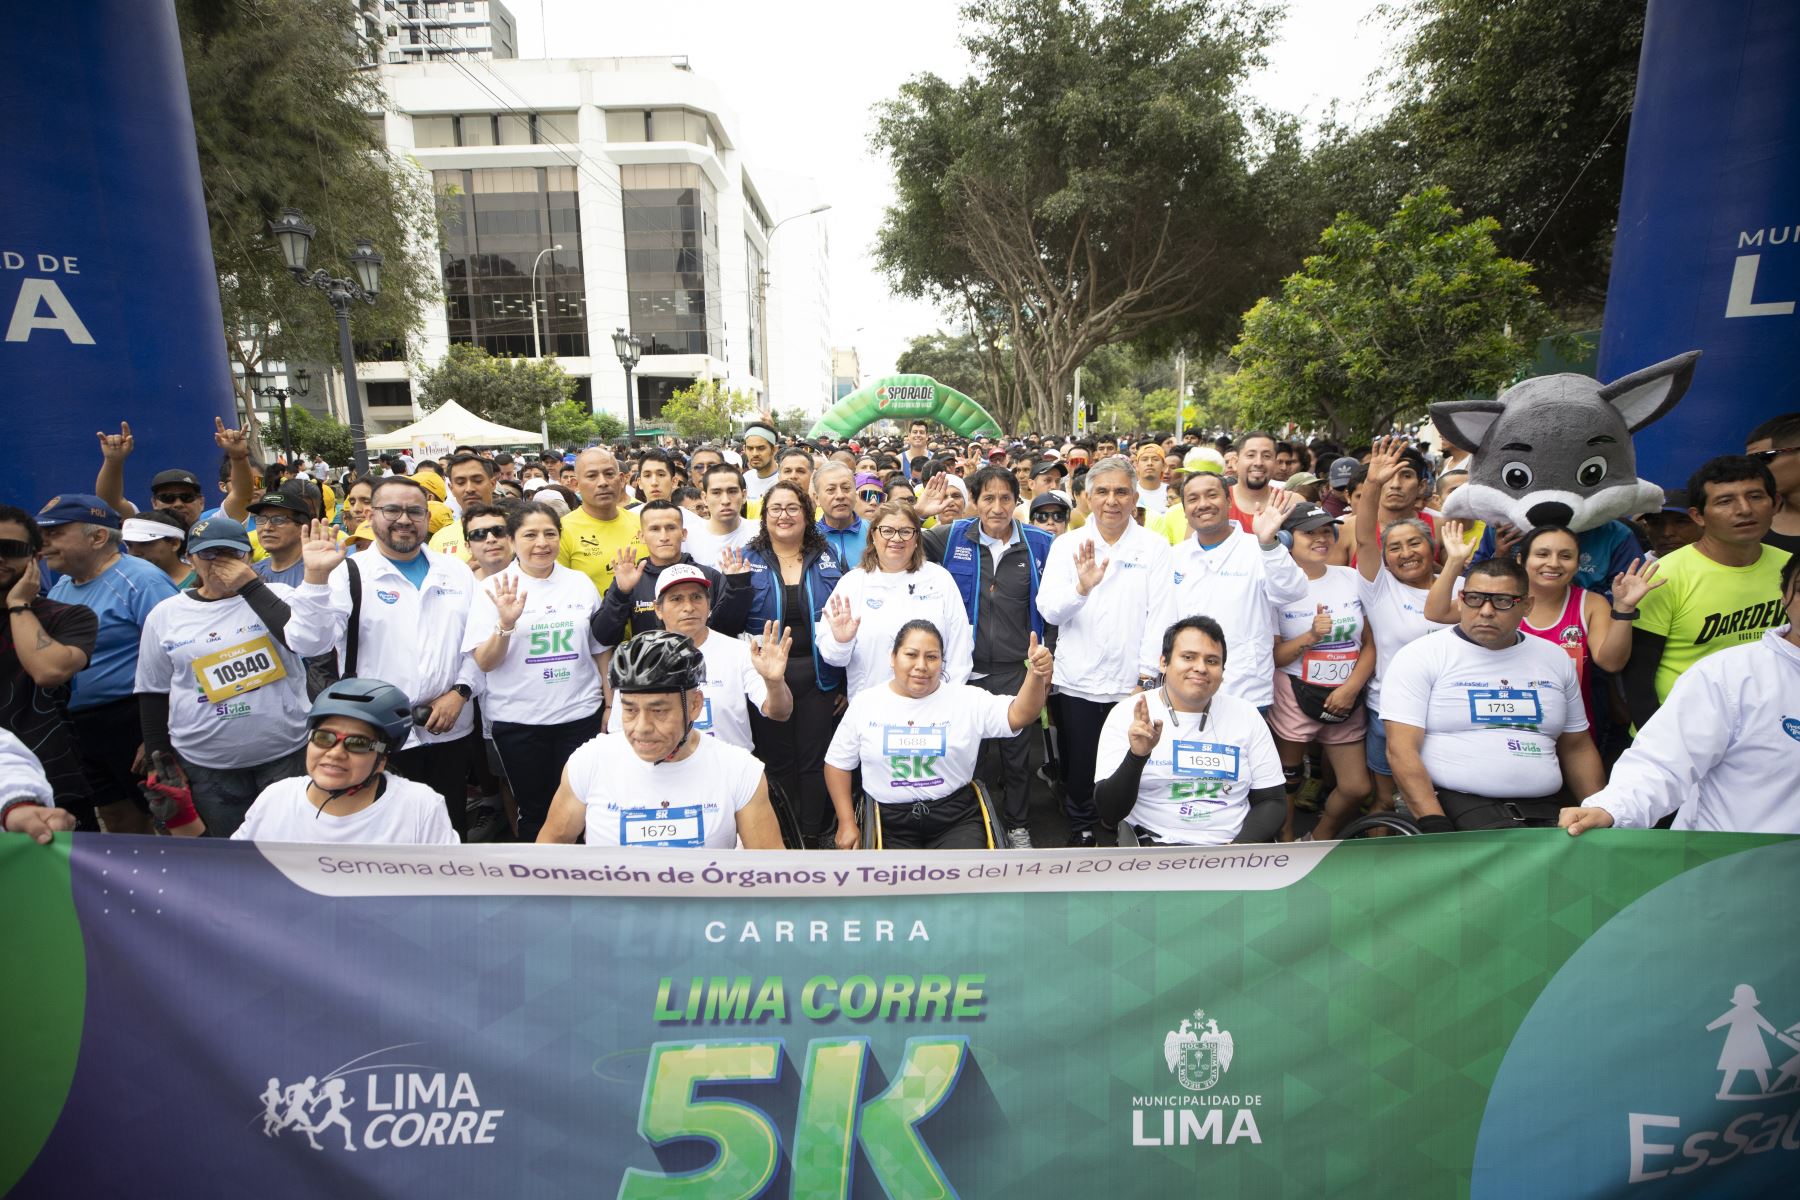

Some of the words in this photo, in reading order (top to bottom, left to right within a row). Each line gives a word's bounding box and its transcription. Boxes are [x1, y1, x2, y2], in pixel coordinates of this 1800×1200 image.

[0, 251, 25, 270] D
[38, 254, 80, 274] DE
[1725, 254, 1796, 318] L
[5, 278, 97, 345] A
[888, 386, 933, 399] SPORADE
[819, 562, 837, 570] LIMA
[529, 628, 574, 655] 5K
[213, 652, 270, 685] 10940
[228, 704, 251, 714] vida
[1488, 703, 1515, 713] 1713
[900, 738, 927, 746] 1688
[1522, 744, 1541, 752] vida
[891, 755, 938, 778] 5K
[1190, 756, 1220, 767] 1639
[641, 825, 677, 838] 1679
[318, 856, 433, 876] Semana
[439, 860, 475, 877] de
[480, 862, 504, 878] la
[509, 864, 650, 882] Donación
[657, 866, 695, 884] de
[701, 862, 826, 887] Órganos
[833, 870, 849, 886] y
[856, 864, 960, 885] Tejidos
[967, 863, 1007, 879] del
[1015, 862, 1042, 875] 14
[1050, 859, 1072, 874] al
[1077, 859, 1113, 873] 20
[1118, 856, 1151, 872] de
[1157, 852, 1289, 870] setiembre
[705, 920, 929, 943] CARRERA
[652, 976, 787, 1022] LIMA
[801, 973, 988, 1019] CORRE
[367, 1072, 481, 1111] LIMA
[1132, 1095, 1240, 1107] MUNICIPALIDAD
[1245, 1095, 1262, 1106] DE
[616, 1034, 973, 1200] 5K
[1132, 1109, 1263, 1146] LIMA
[363, 1109, 505, 1150] CORRE
